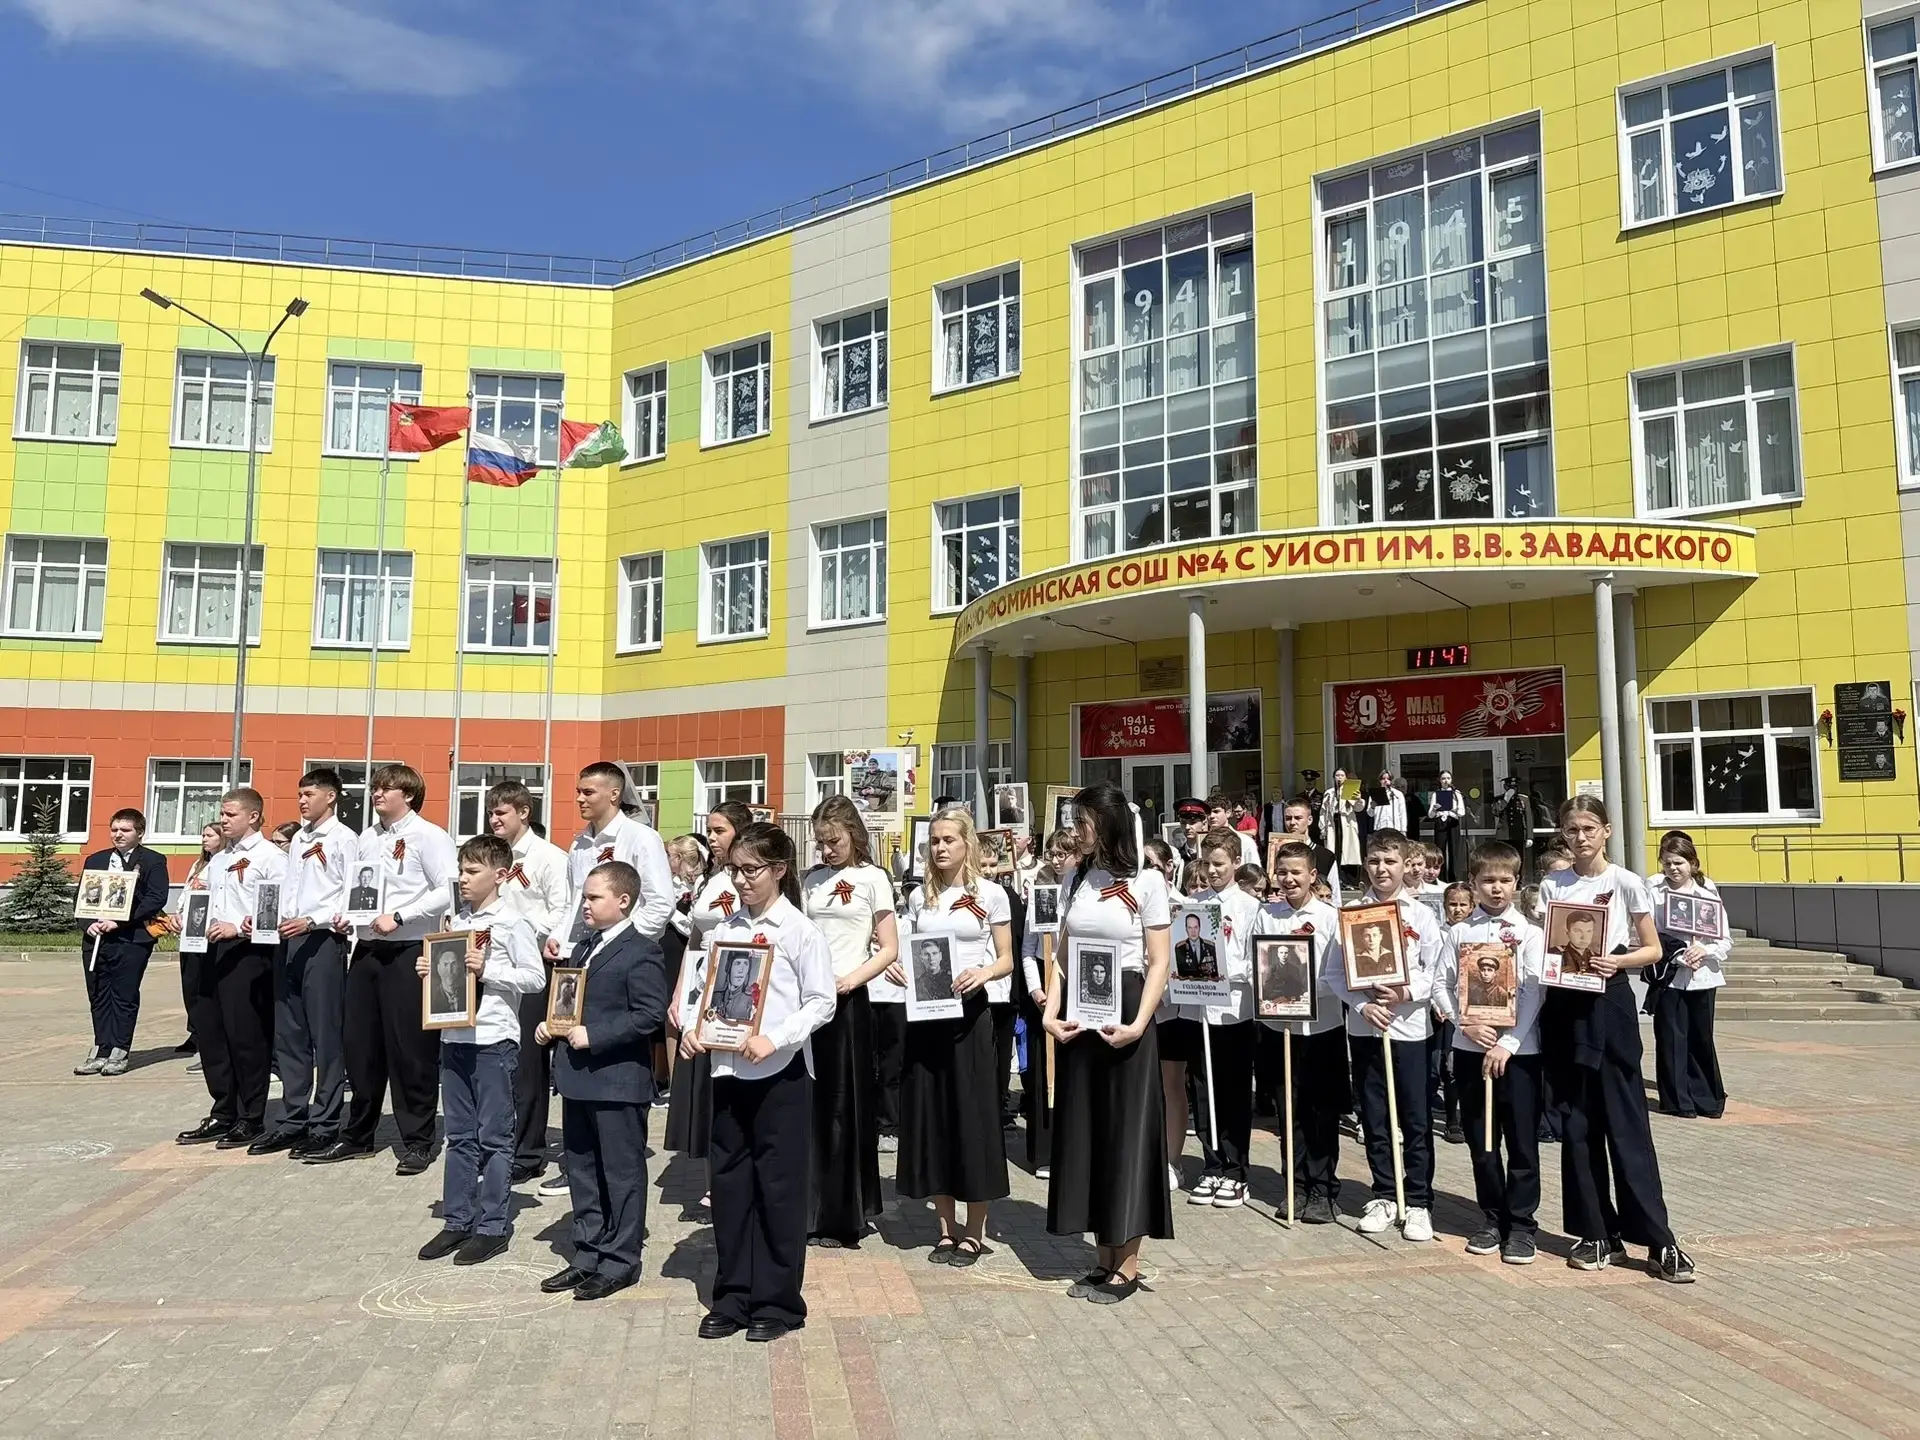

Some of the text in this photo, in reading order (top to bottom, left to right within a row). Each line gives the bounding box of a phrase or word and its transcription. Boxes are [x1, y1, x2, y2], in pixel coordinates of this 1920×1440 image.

[1107, 557, 1168, 589] СОШ
[1178, 549, 1229, 579] №4
[1235, 546, 1256, 571] С
[1263, 538, 1365, 568] УИОП
[1376, 534, 1445, 561] ИМ.
[1359, 695, 1378, 726] 9
[1406, 695, 1444, 714] МАЯ
[1407, 714, 1446, 726] 1941-1945
[1128, 725, 1156, 735] 1945
